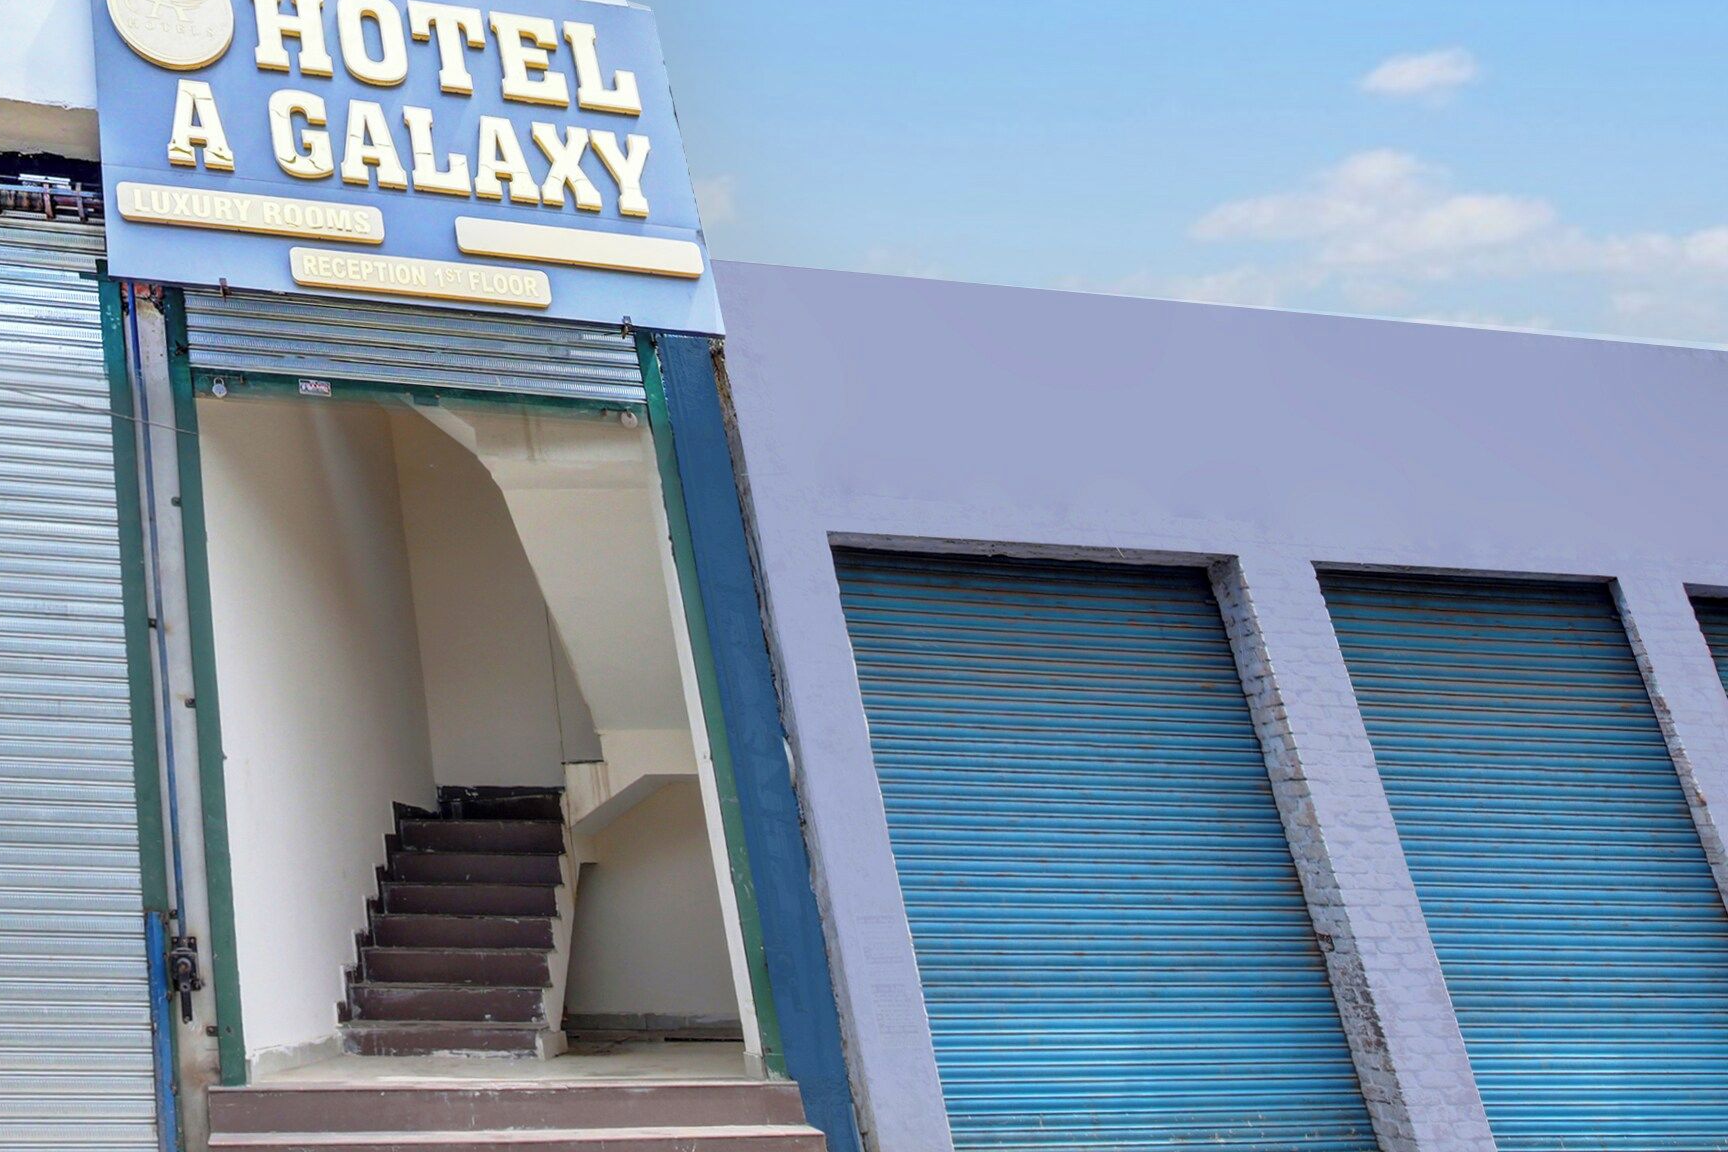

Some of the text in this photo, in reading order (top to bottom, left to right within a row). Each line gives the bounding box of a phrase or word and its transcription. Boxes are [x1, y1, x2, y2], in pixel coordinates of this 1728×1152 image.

[167, 79, 651, 217] A GALAXY
[133, 189, 372, 235] LUXURY ROOMS
[302, 254, 539, 297] RECEPTION 1ST FLOOR
